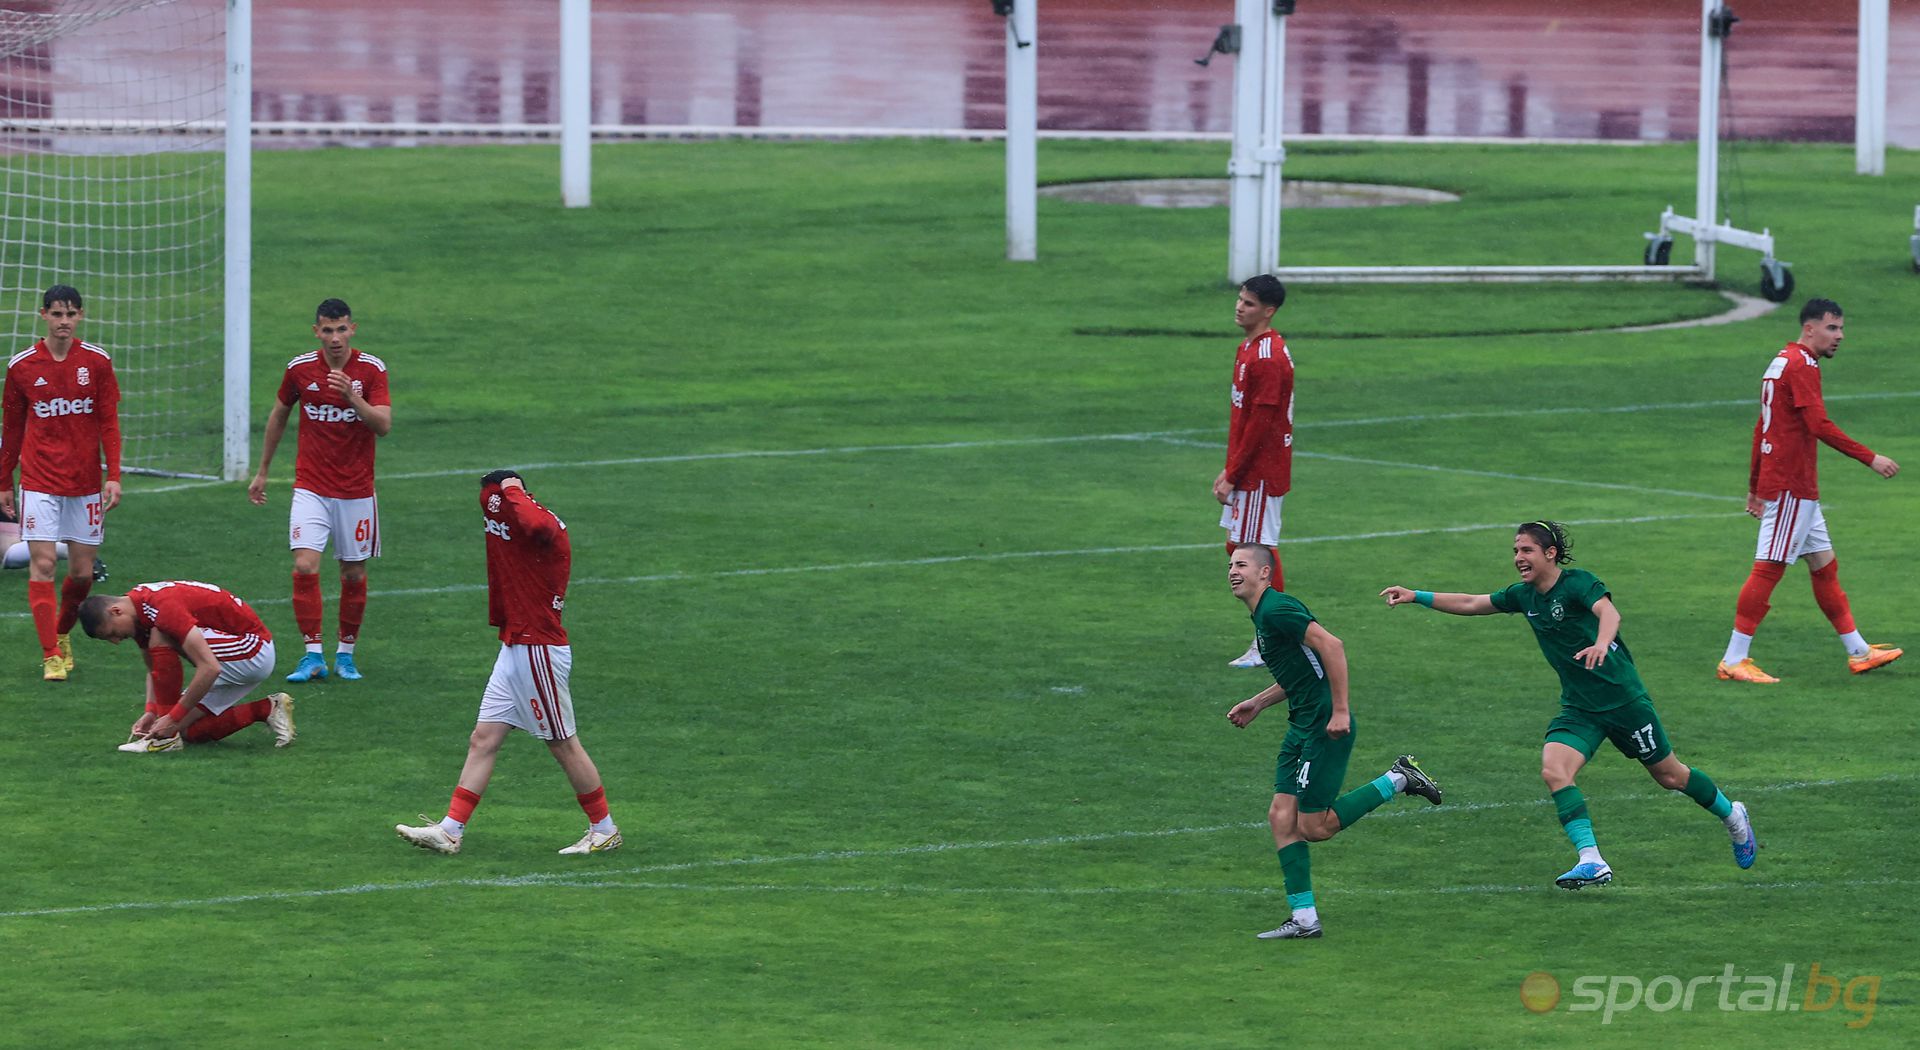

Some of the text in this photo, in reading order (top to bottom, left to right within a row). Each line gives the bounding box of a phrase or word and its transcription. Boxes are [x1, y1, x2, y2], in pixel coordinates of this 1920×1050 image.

[33, 397, 94, 418] efbet
[304, 403, 363, 423] efbe
[86, 502, 101, 526] 15
[355, 518, 370, 542] 61
[530, 698, 544, 721] 8
[1632, 723, 1657, 753] 17
